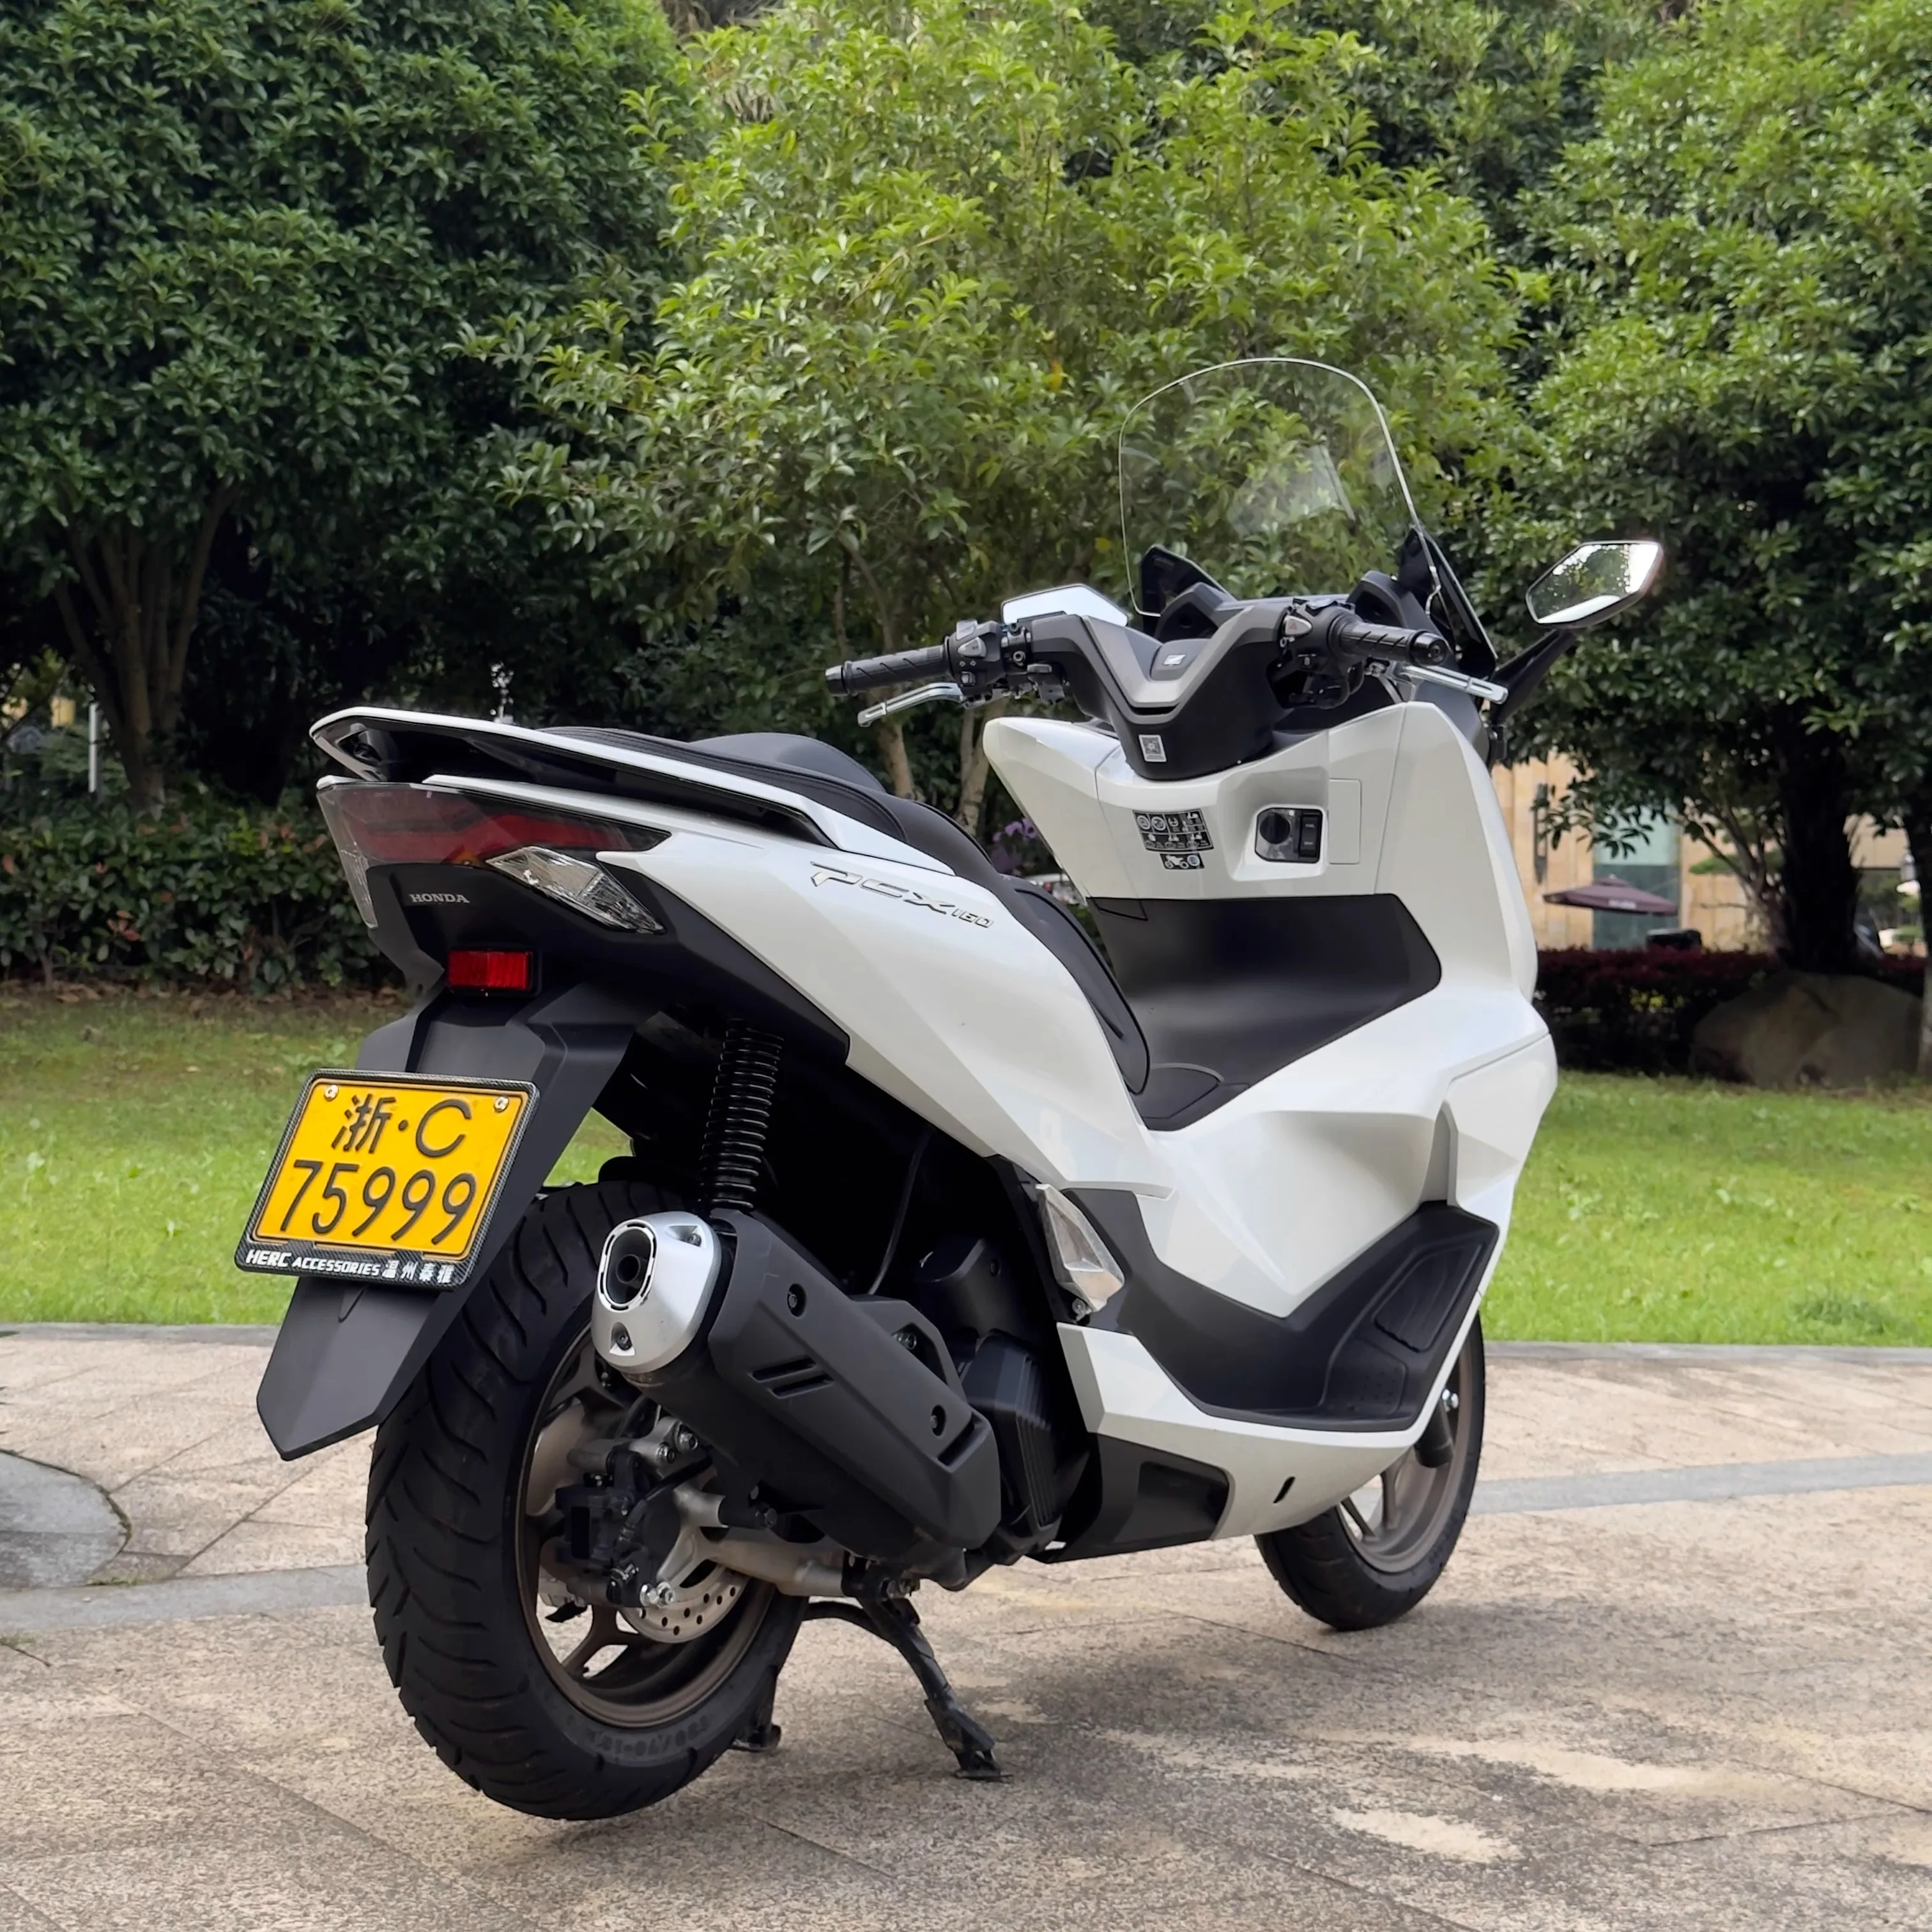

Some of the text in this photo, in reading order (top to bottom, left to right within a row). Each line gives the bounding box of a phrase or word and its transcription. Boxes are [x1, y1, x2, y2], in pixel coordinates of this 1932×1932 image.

[409, 893, 470, 903] HONDA
[809, 861, 995, 928] PCX 160
[279, 1159, 477, 1245] 75999
[245, 1249, 381, 1276] HERC ACCESSORIES
